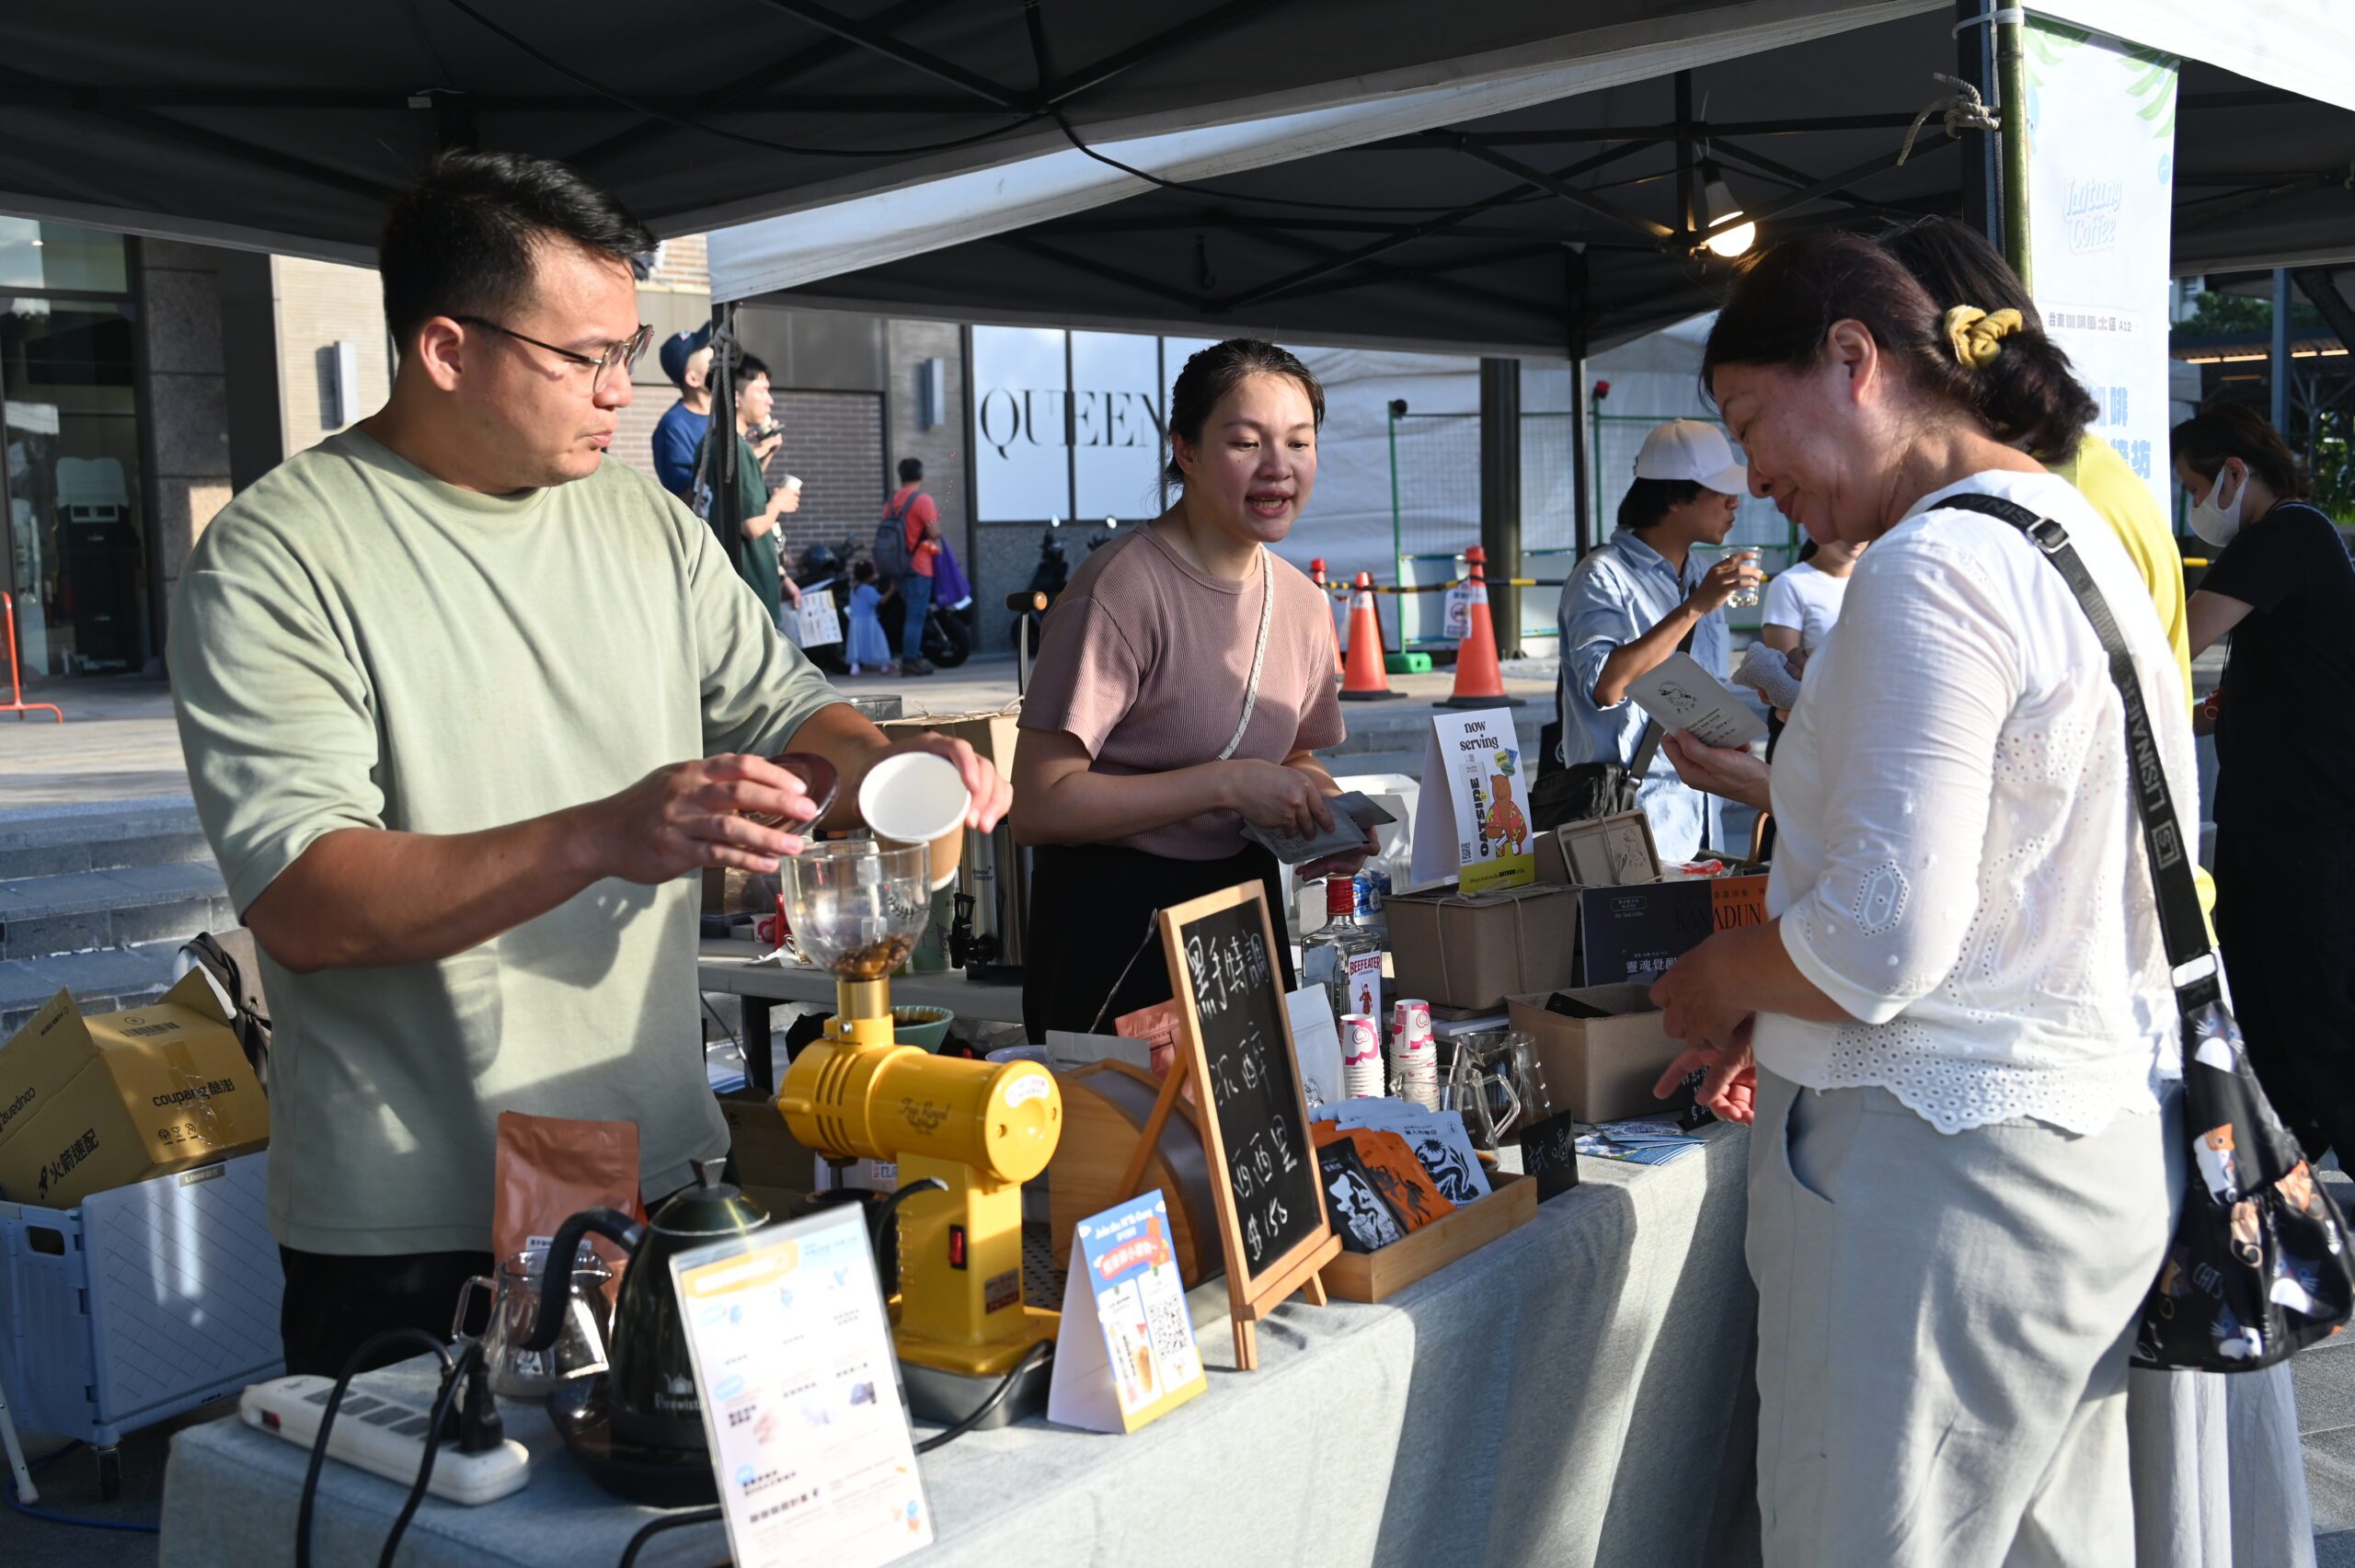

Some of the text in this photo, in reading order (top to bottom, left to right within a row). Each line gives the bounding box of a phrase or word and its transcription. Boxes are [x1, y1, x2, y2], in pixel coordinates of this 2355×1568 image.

[2074, 215, 2116, 249] Coffee
[2120, 321, 2132, 332] A12
[1460, 734, 1499, 751] serving
[1465, 721, 1486, 733] now
[1470, 777, 1489, 856] OATSIDE
[1350, 956, 1381, 977] BEEFEATER
[153, 1077, 236, 1106] coupang 酷澎
[50, 1127, 99, 1185] 火箭速配
[1232, 1114, 1298, 1199] 西西里
[1528, 1127, 1569, 1177] 試喝
